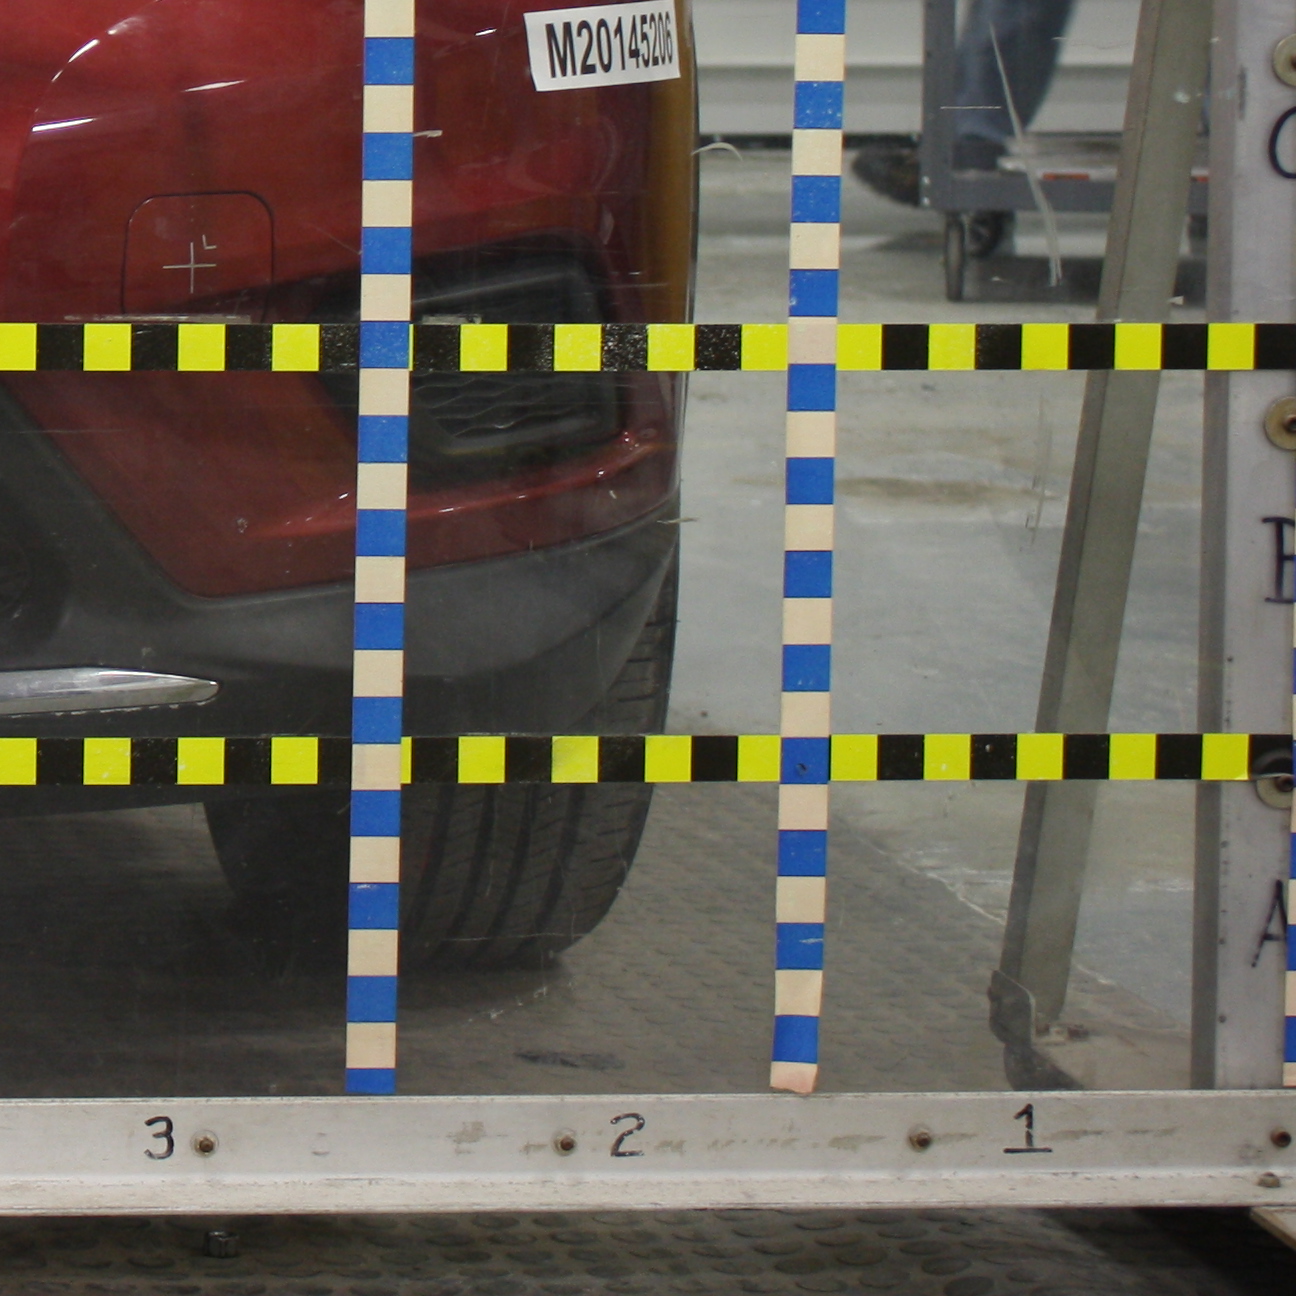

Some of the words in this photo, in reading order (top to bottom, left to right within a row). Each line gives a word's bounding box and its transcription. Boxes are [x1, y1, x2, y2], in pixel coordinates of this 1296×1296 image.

[544, 10, 674, 79] M20145206
[144, 1115, 175, 1160] 3
[610, 1112, 645, 1158] 2
[1003, 1103, 1053, 1154] 1
